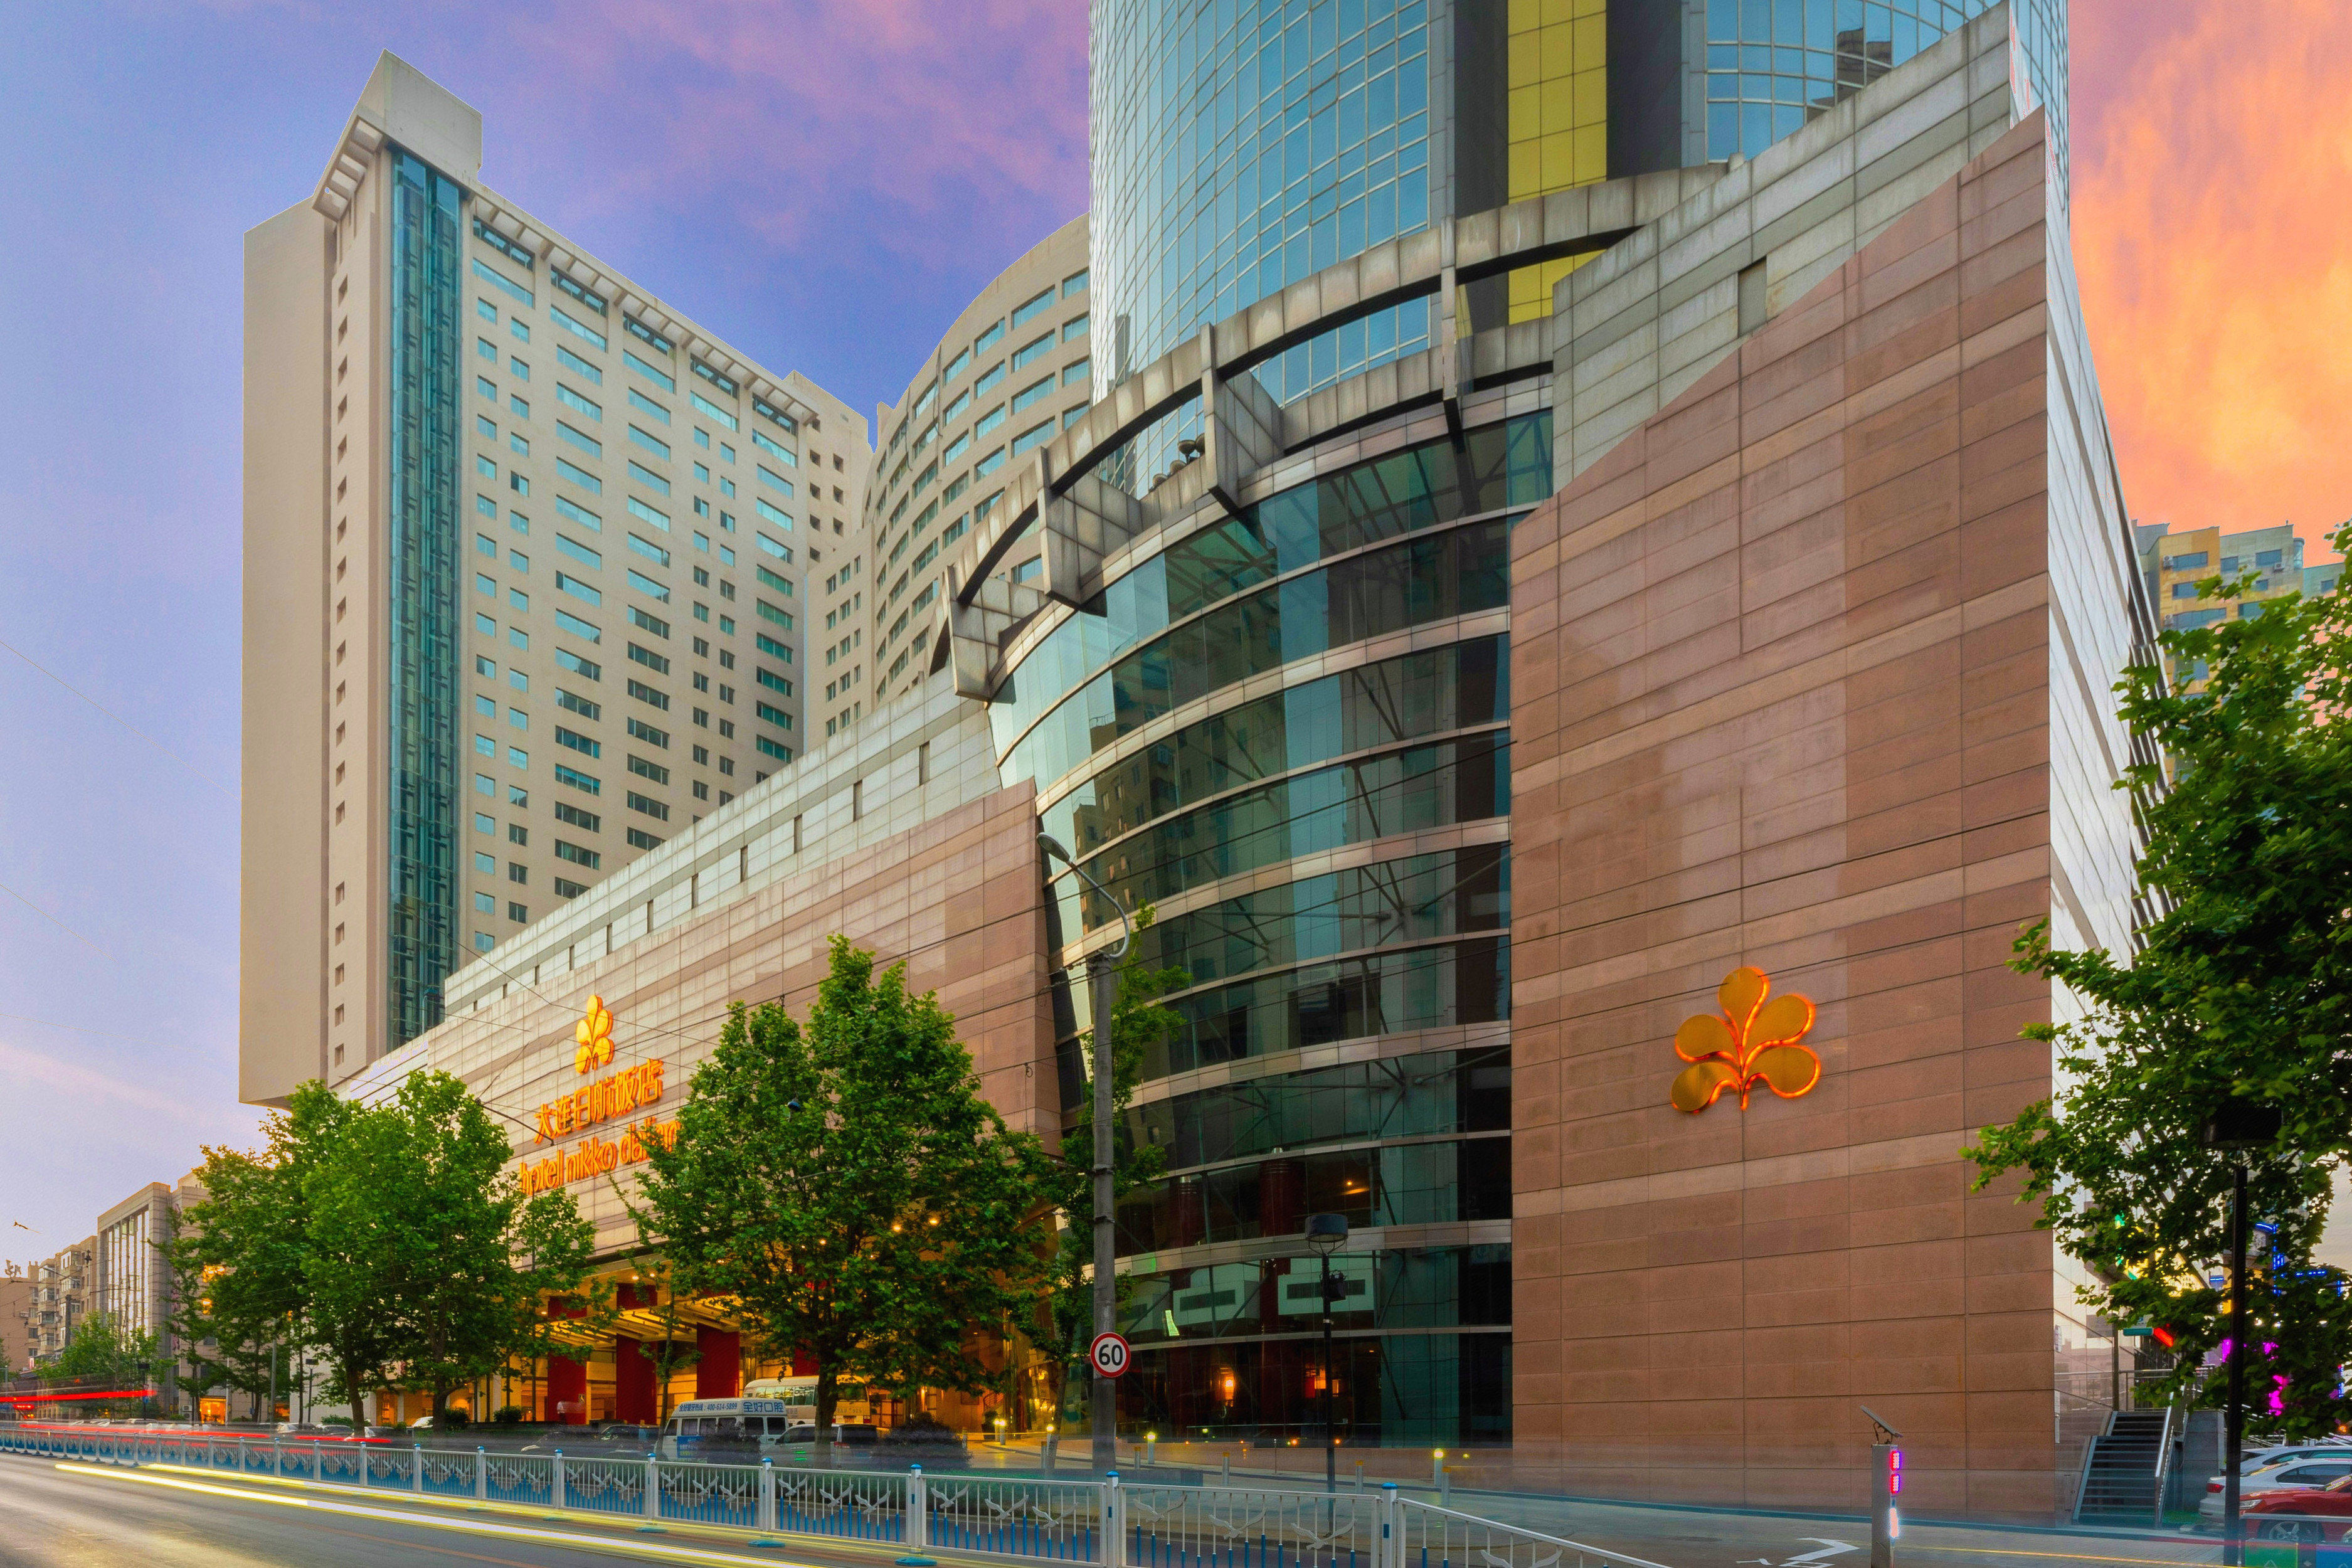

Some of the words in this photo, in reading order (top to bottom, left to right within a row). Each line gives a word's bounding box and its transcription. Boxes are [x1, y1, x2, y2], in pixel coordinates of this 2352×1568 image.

[534, 1059, 664, 1145] 大连日航饭店
[520, 1149, 564, 1195] hotel
[567, 1136, 617, 1182] nikko
[618, 1116, 681, 1164] dan
[1098, 1344, 1123, 1366] 60
[743, 1401, 783, 1412] 全好口腔
